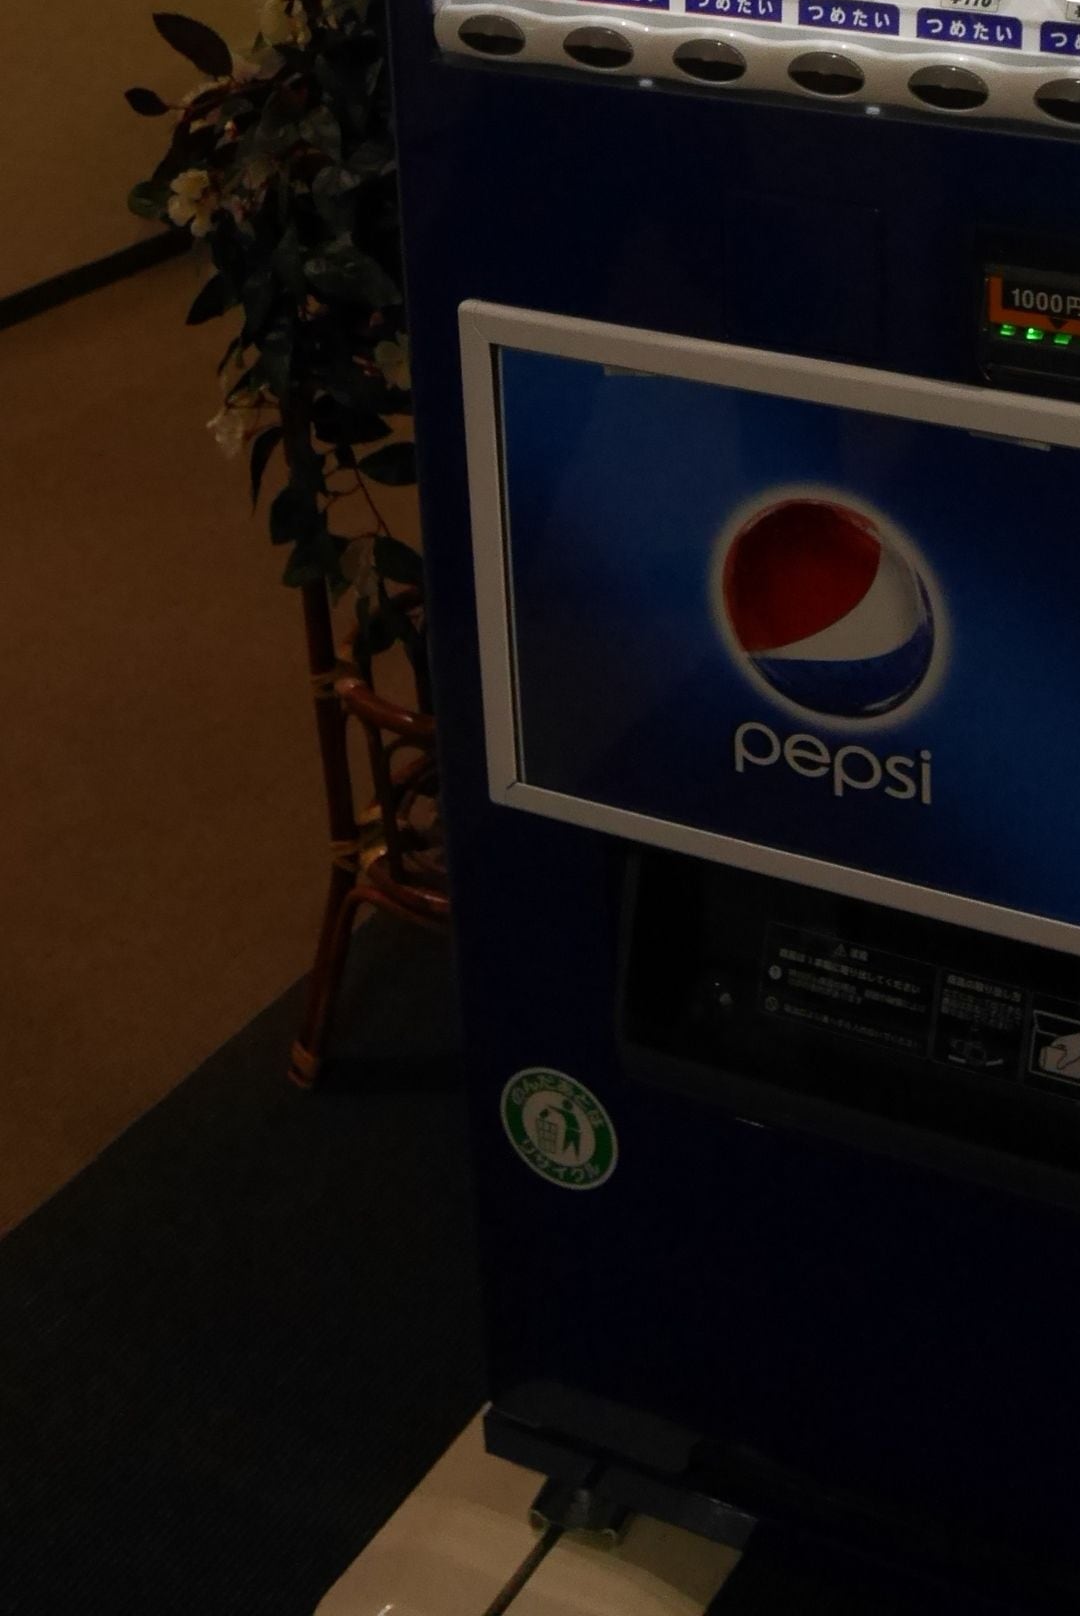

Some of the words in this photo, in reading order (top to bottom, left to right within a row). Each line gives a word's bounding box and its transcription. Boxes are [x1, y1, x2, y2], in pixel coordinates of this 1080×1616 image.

[808, 4, 890, 29] つめたい
[926, 17, 1013, 42] つめたい
[733, 720, 932, 805] pepsi
